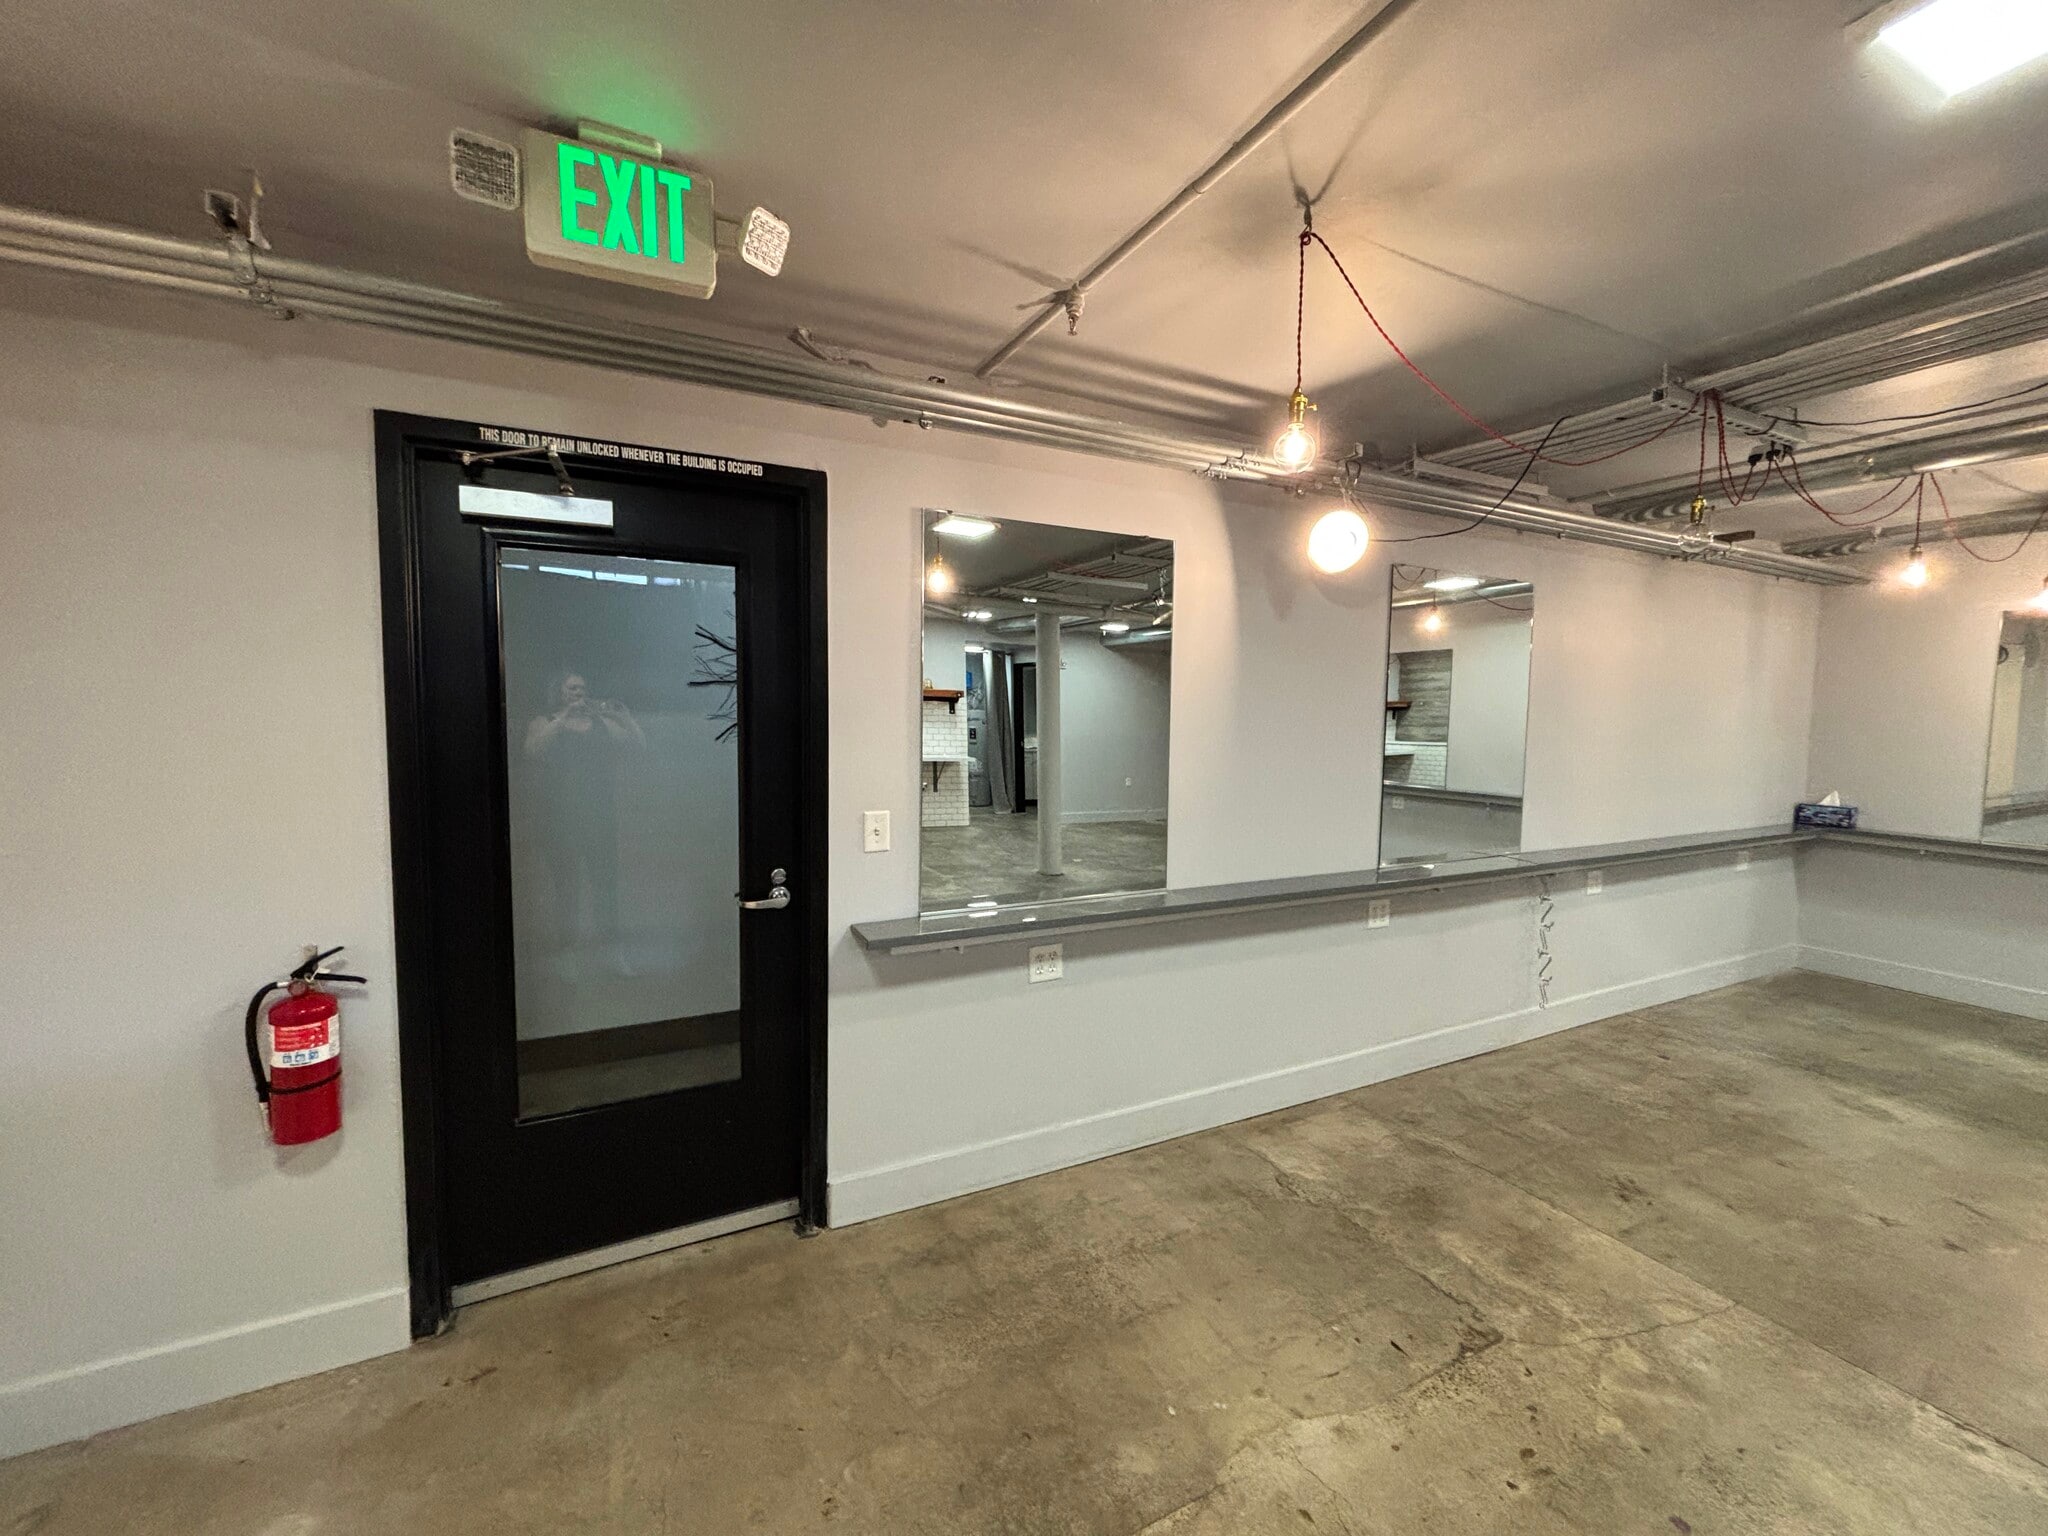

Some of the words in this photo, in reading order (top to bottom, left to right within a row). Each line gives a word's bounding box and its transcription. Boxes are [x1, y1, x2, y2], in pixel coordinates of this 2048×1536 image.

[558, 143, 691, 263] EXIT
[479, 427, 500, 442] THIS
[502, 430, 526, 445] DOOR
[528, 434, 540, 447] TO
[576, 440, 619, 458] UNLOCKED
[621, 446, 665, 464] WHENEVER
[665, 452, 681, 466] THE
[682, 454, 717, 471] BUILDING
[719, 460, 726, 472] IS
[727, 461, 763, 477] OCCUPIED
